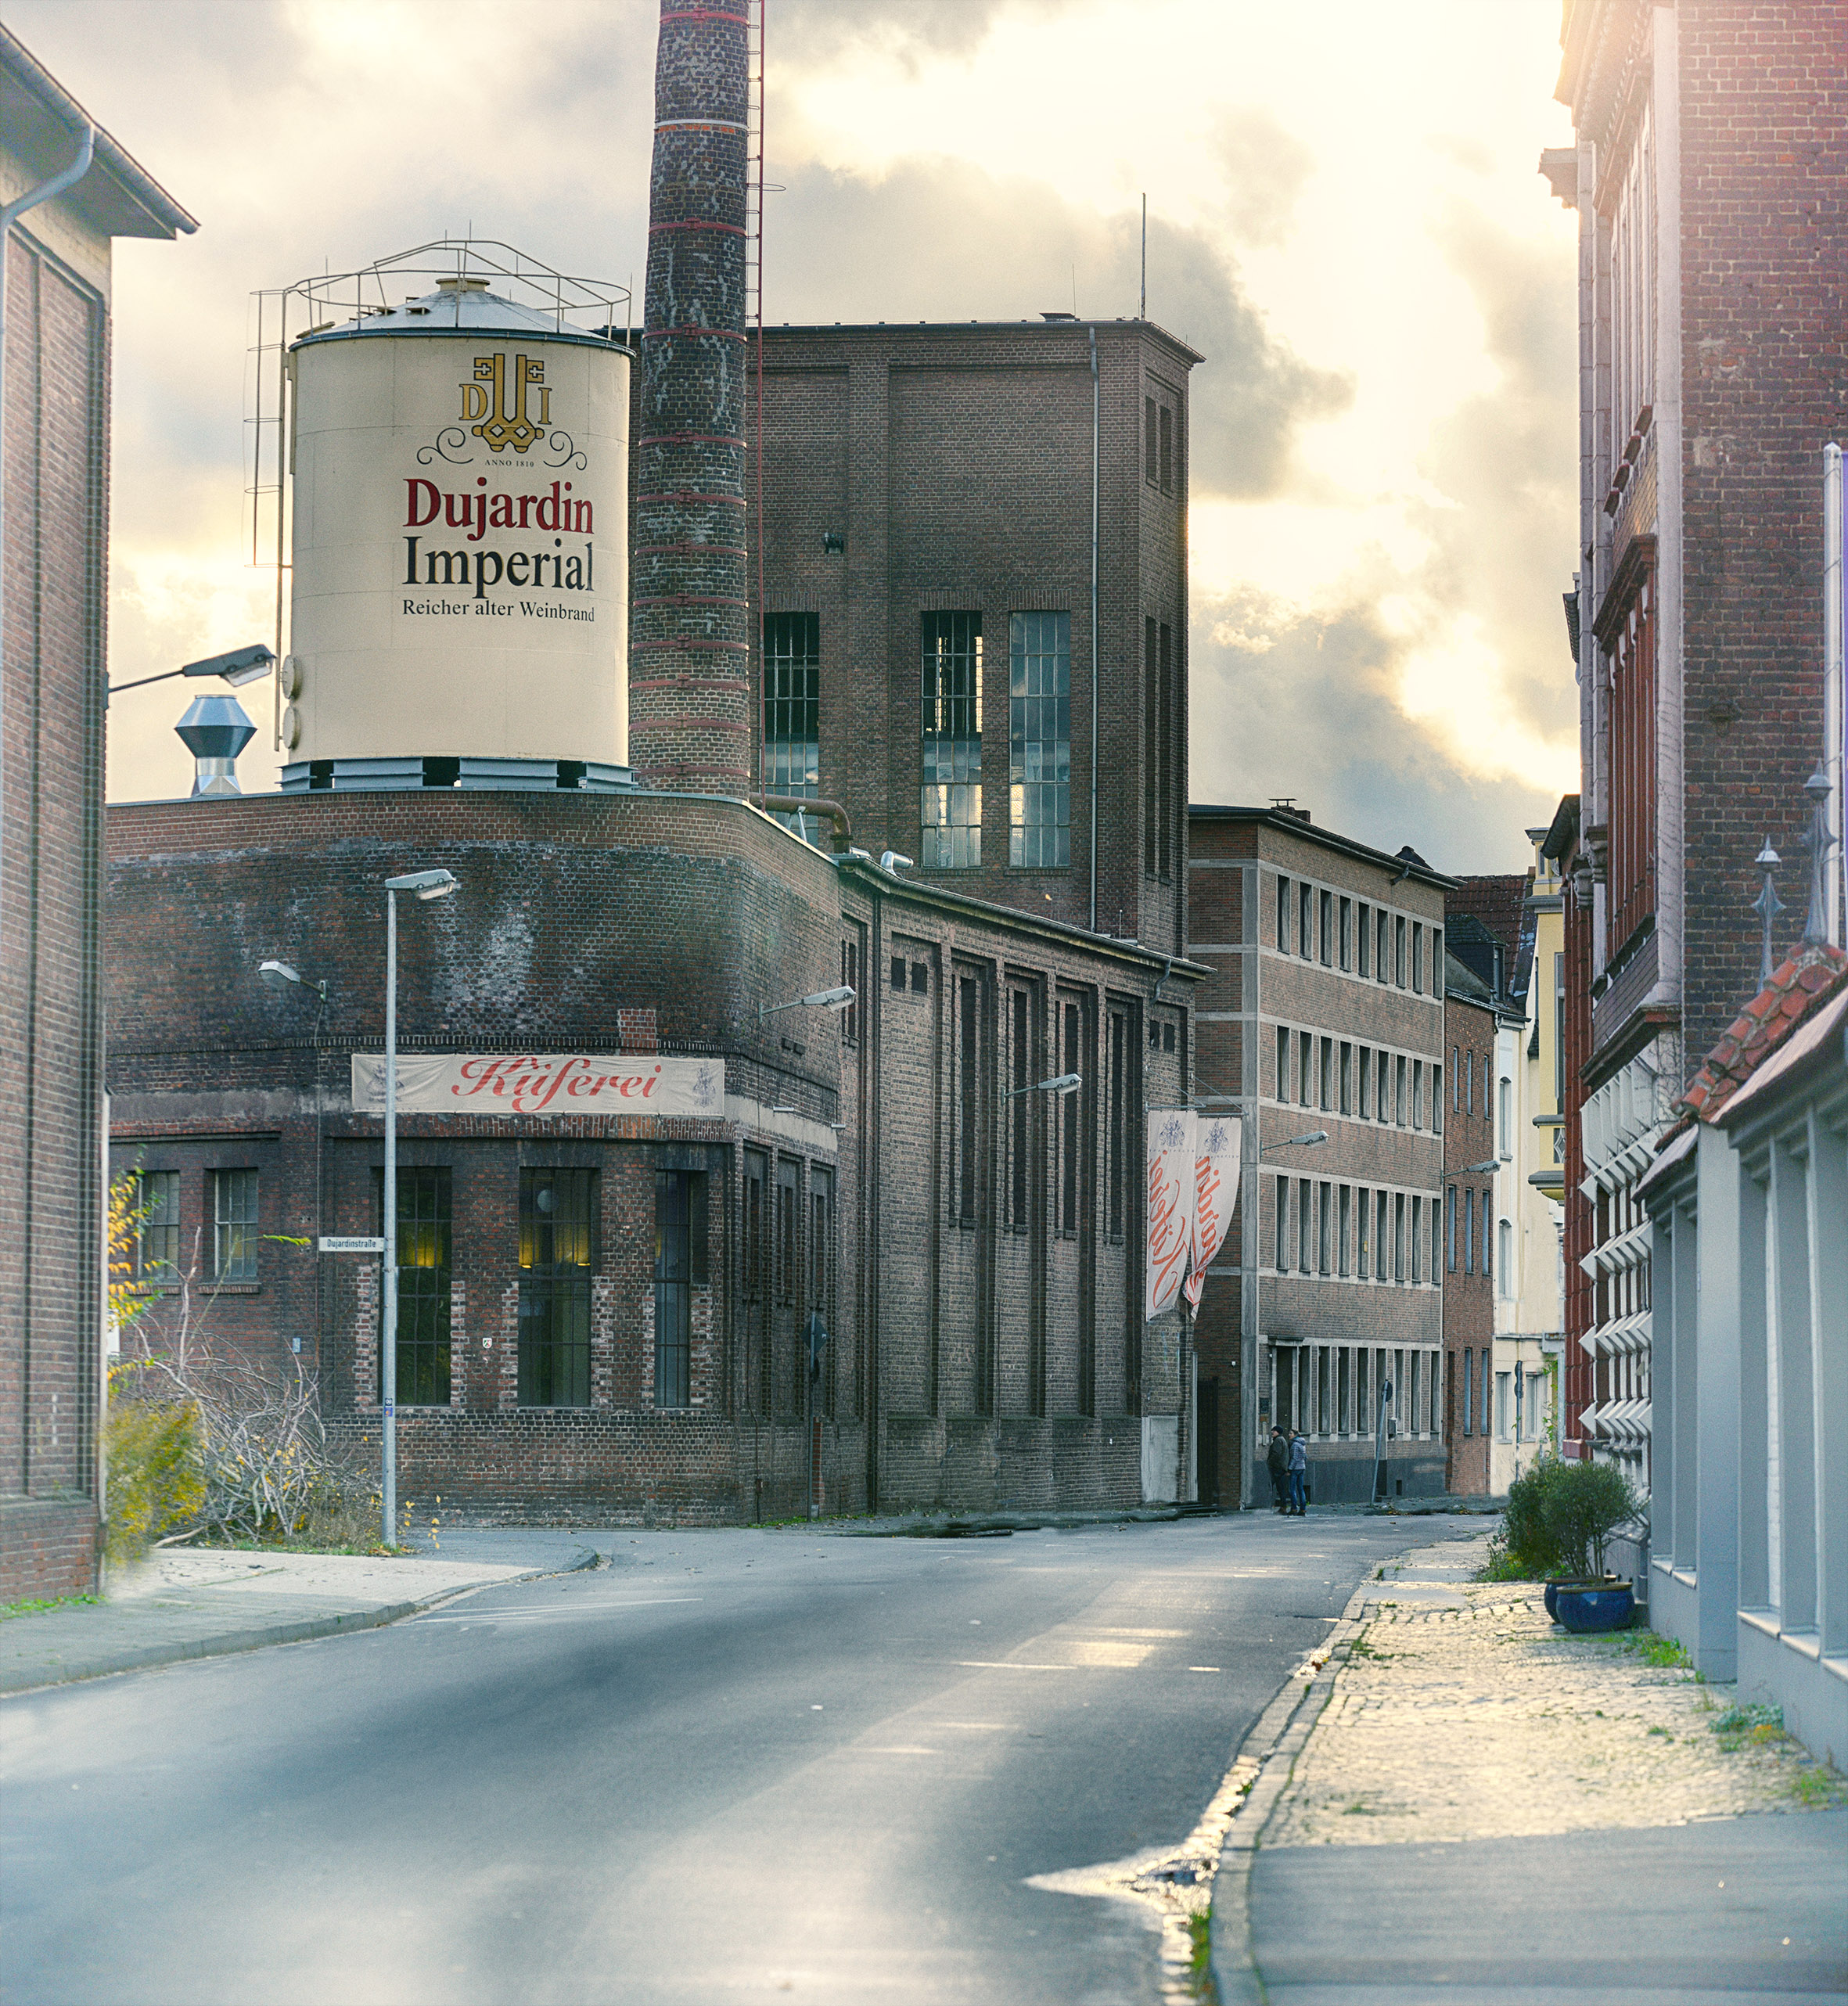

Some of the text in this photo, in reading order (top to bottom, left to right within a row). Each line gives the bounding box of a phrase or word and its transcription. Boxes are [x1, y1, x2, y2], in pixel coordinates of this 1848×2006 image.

[402, 476, 595, 541] Dujardin
[401, 535, 595, 599] Imperial
[402, 599, 595, 622] Reicher alter Weinbrand
[451, 1055, 663, 1114] Küferei
[327, 1238, 376, 1249] Dujardinstraße
